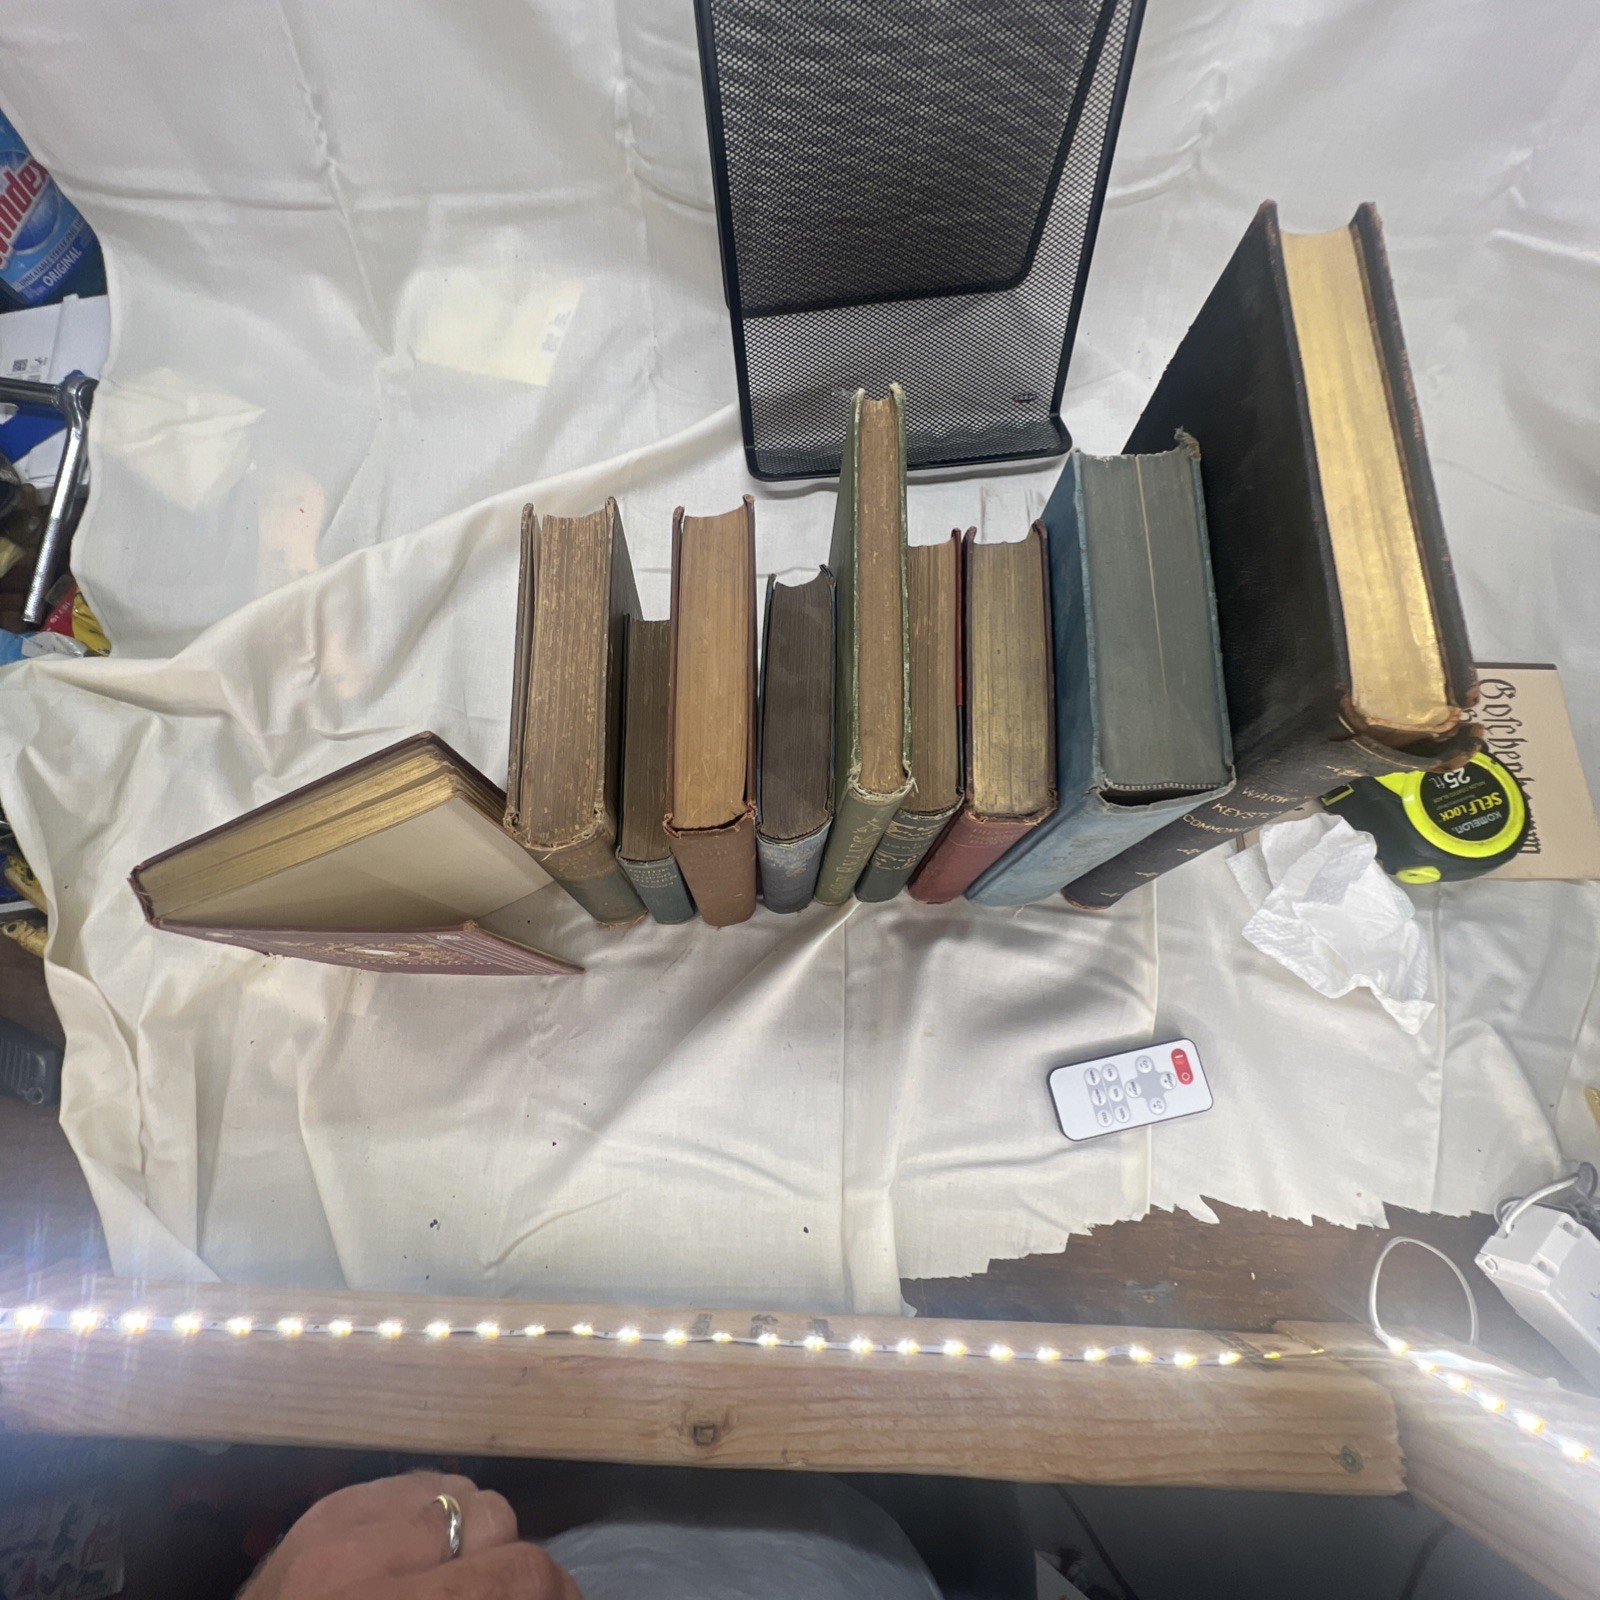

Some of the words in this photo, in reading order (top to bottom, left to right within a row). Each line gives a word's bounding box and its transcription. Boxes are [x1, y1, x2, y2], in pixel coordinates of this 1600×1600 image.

[42, 245, 83, 288] ORIGINAL
[1443, 767, 1471, 789] 25
[1440, 806, 1467, 821] LOCK
[1467, 792, 1503, 816] SELF
